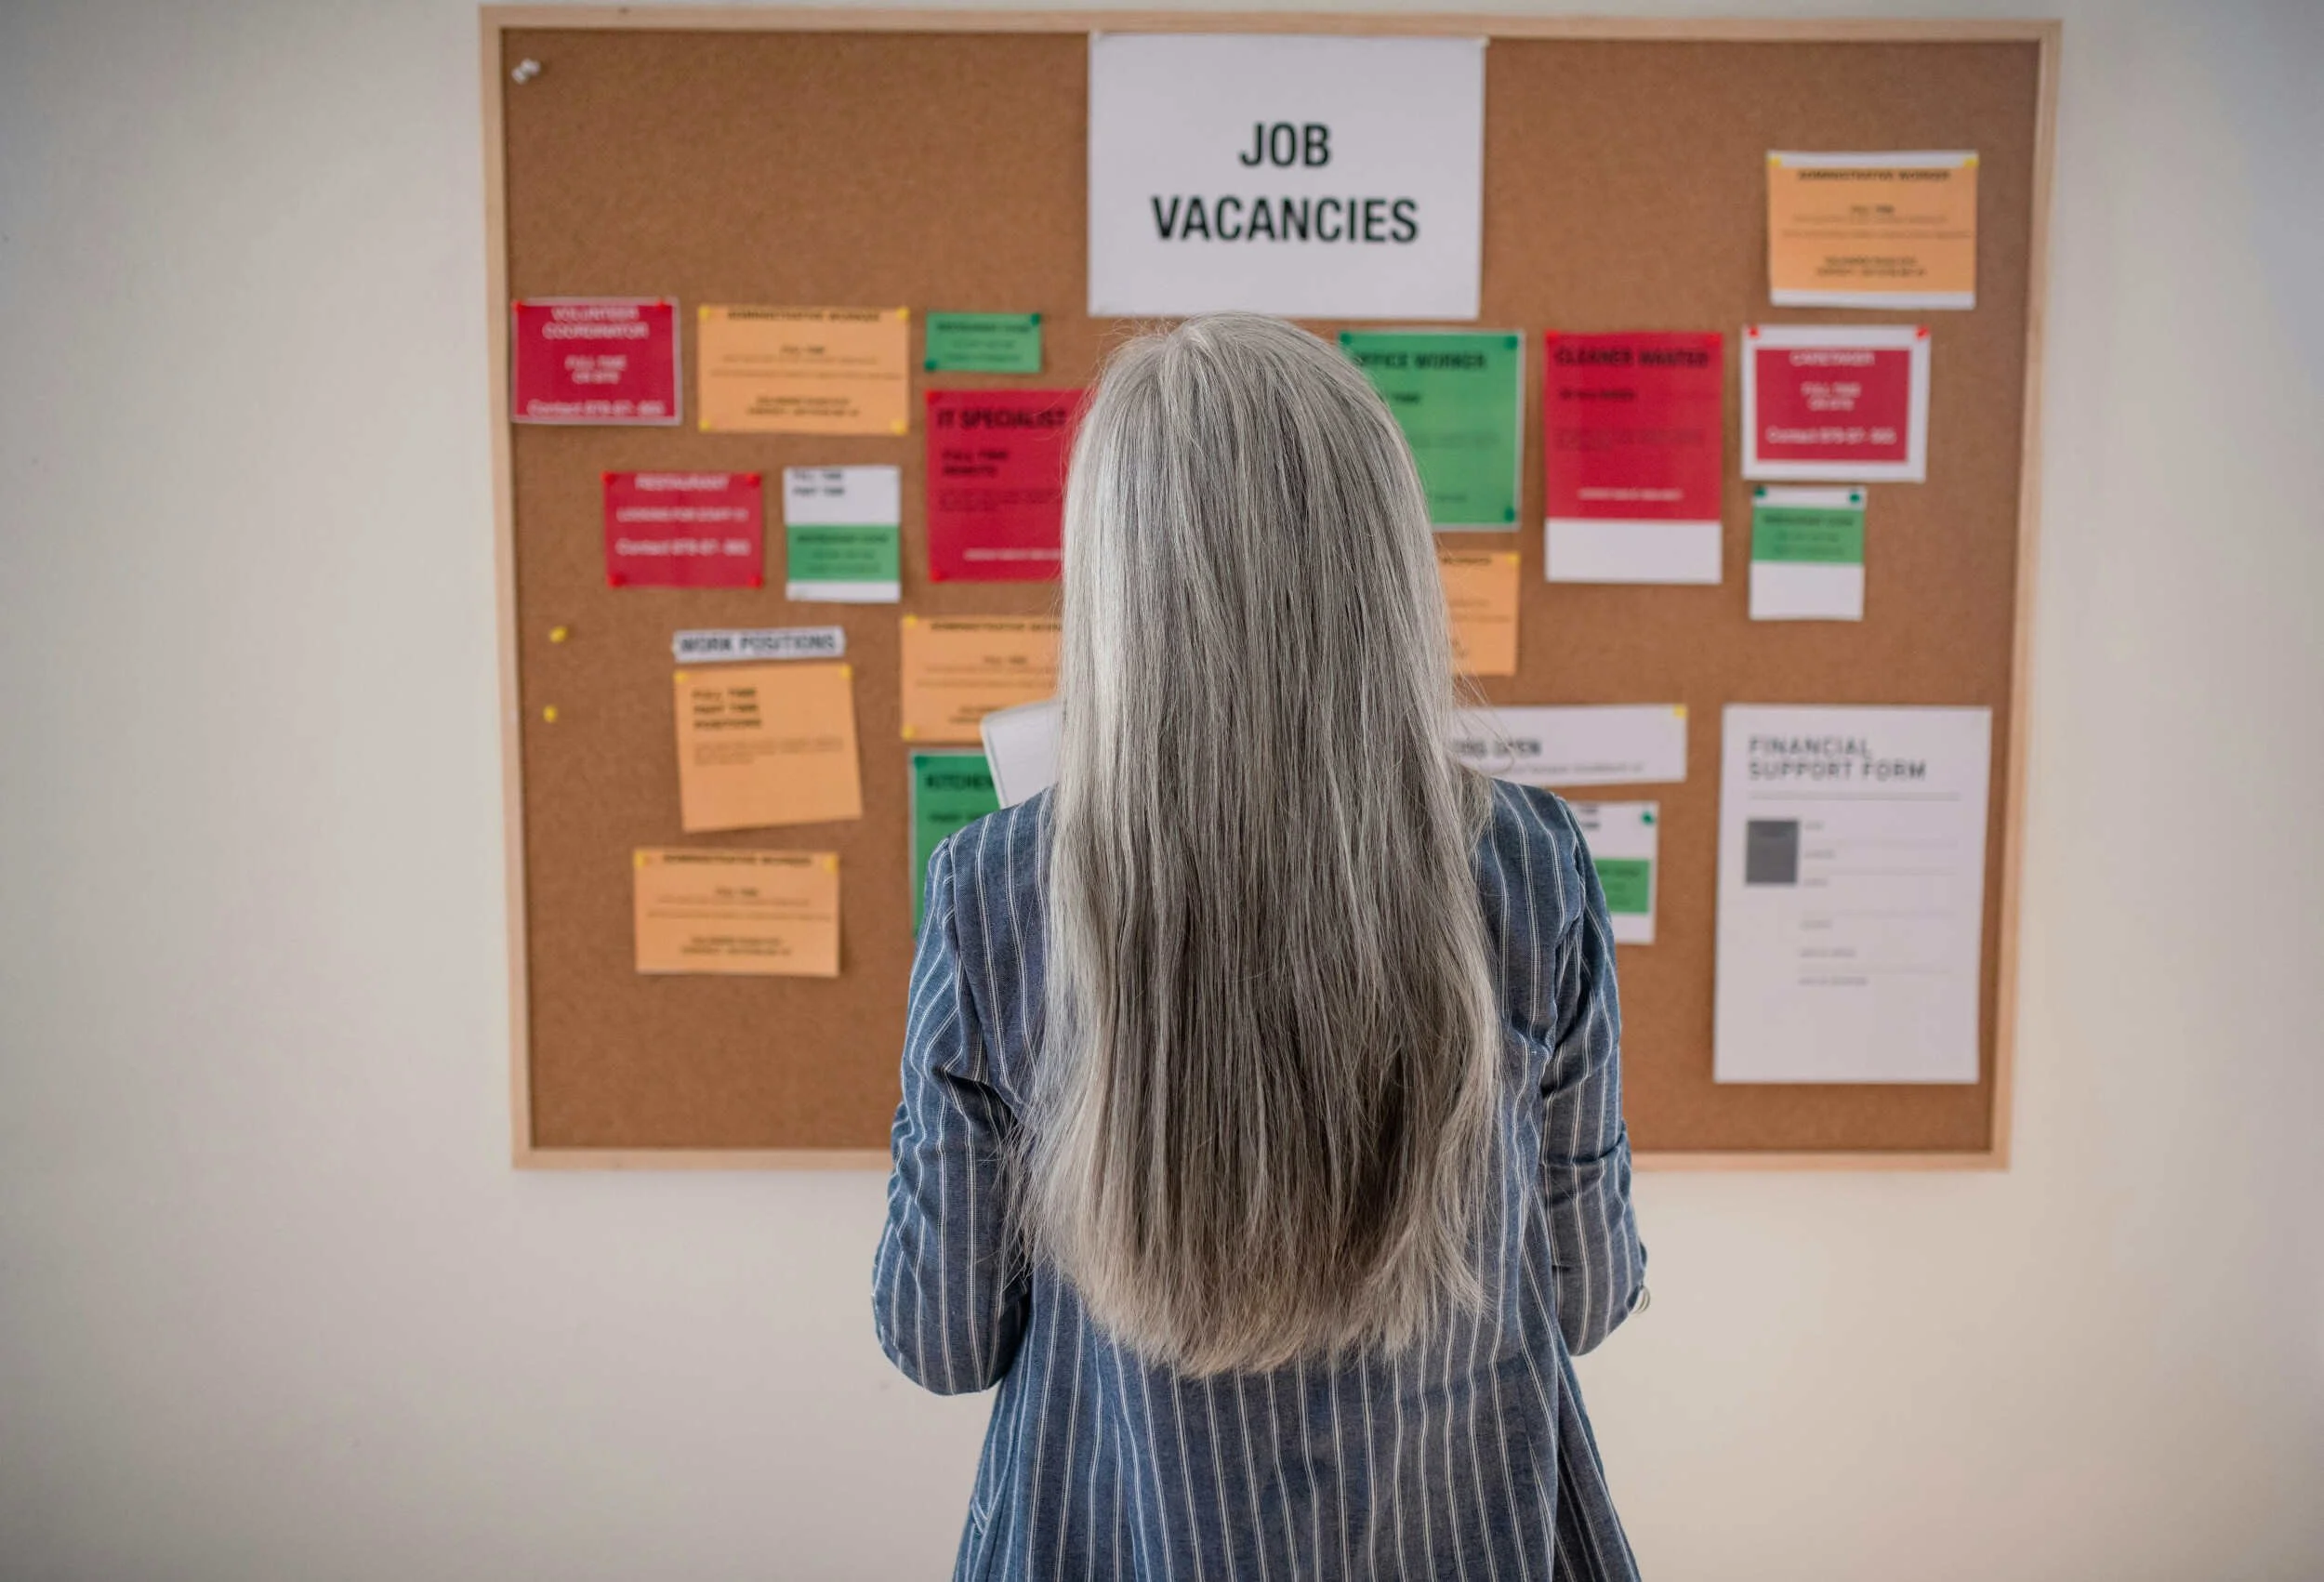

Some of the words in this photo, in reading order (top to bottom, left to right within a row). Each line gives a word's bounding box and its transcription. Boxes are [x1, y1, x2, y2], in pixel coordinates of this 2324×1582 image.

[1239, 121, 1332, 168] JOB
[1151, 194, 1419, 244] VACANCIES
[551, 306, 640, 321] VOLUNTEER
[542, 323, 649, 338] COORDINATOR
[1414, 352, 1486, 369] WORKER
[1555, 347, 1631, 366] CLEANER
[1638, 349, 1709, 368] WANTED
[937, 409, 955, 428] IT
[635, 474, 730, 491] RESTAURANT
[680, 637, 733, 652] WORK
[739, 634, 836, 652] POSITIONS
[1748, 734, 1872, 758] FINANCIAL
[1748, 759, 1852, 782] SUPPORT
[1862, 759, 1928, 782] FORM
